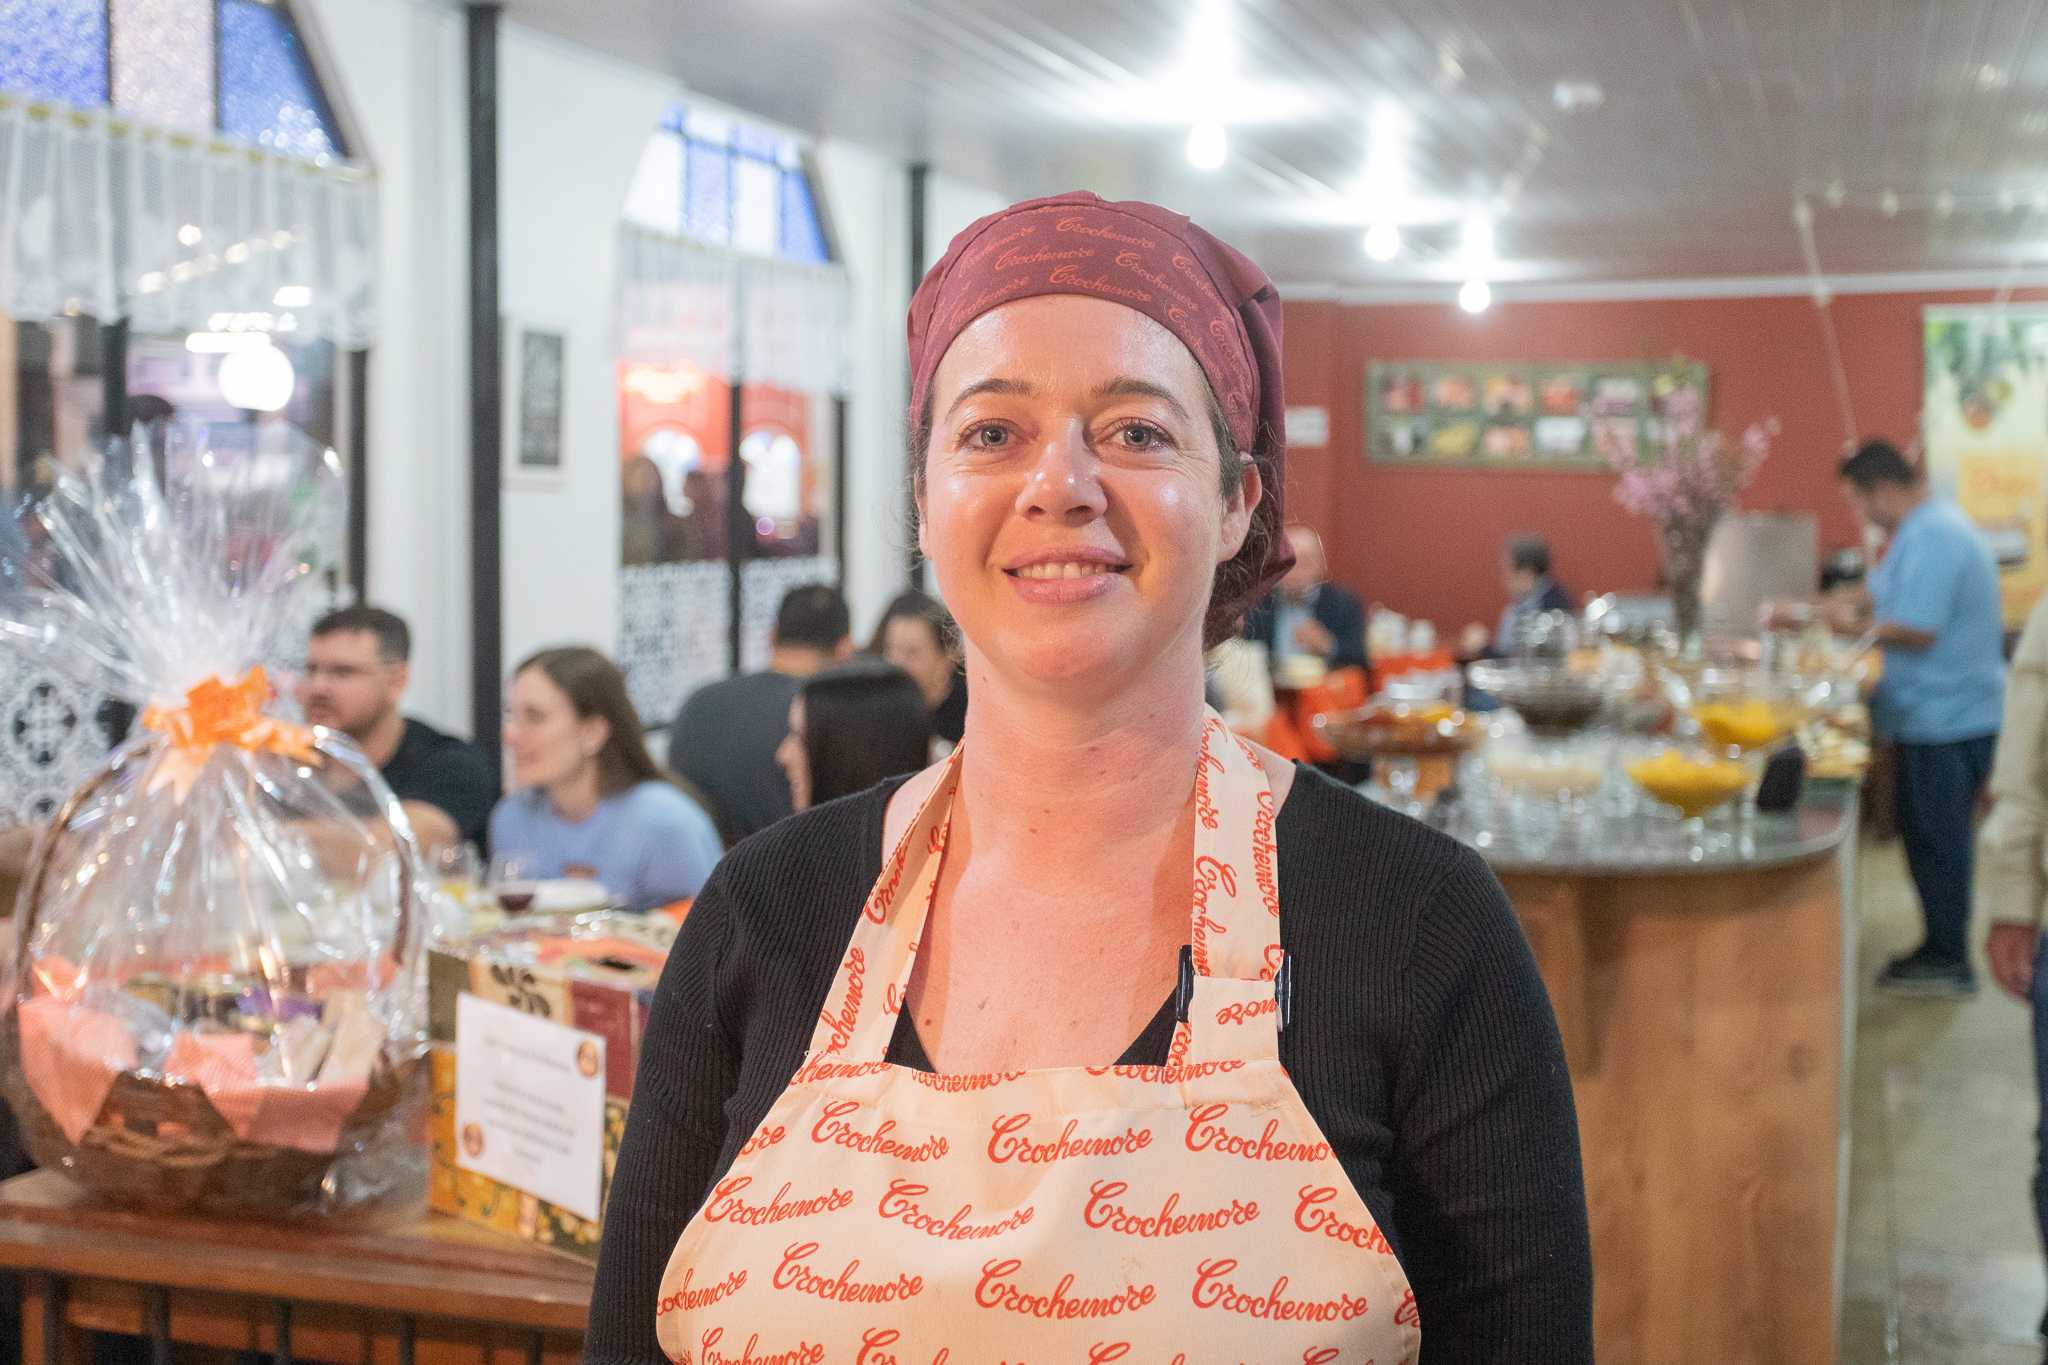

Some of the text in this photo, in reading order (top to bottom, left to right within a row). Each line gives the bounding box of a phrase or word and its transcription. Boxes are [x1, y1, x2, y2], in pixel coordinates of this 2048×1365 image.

[994, 246, 1095, 271] Crochemore
[1056, 216, 1156, 249] Crochemore
[1050, 264, 1152, 301] Crochemore
[811, 1101, 949, 1163] Crochemore
[987, 1113, 1153, 1164] Crochemore
[704, 1176, 854, 1227] Crochemore
[878, 1179, 1034, 1241] Crochemore
[1084, 1179, 1260, 1238] Crochemore
[773, 1242, 924, 1303] Crochemore
[975, 1259, 1157, 1320] Crochemore
[1192, 1258, 1369, 1322] Crochemore
